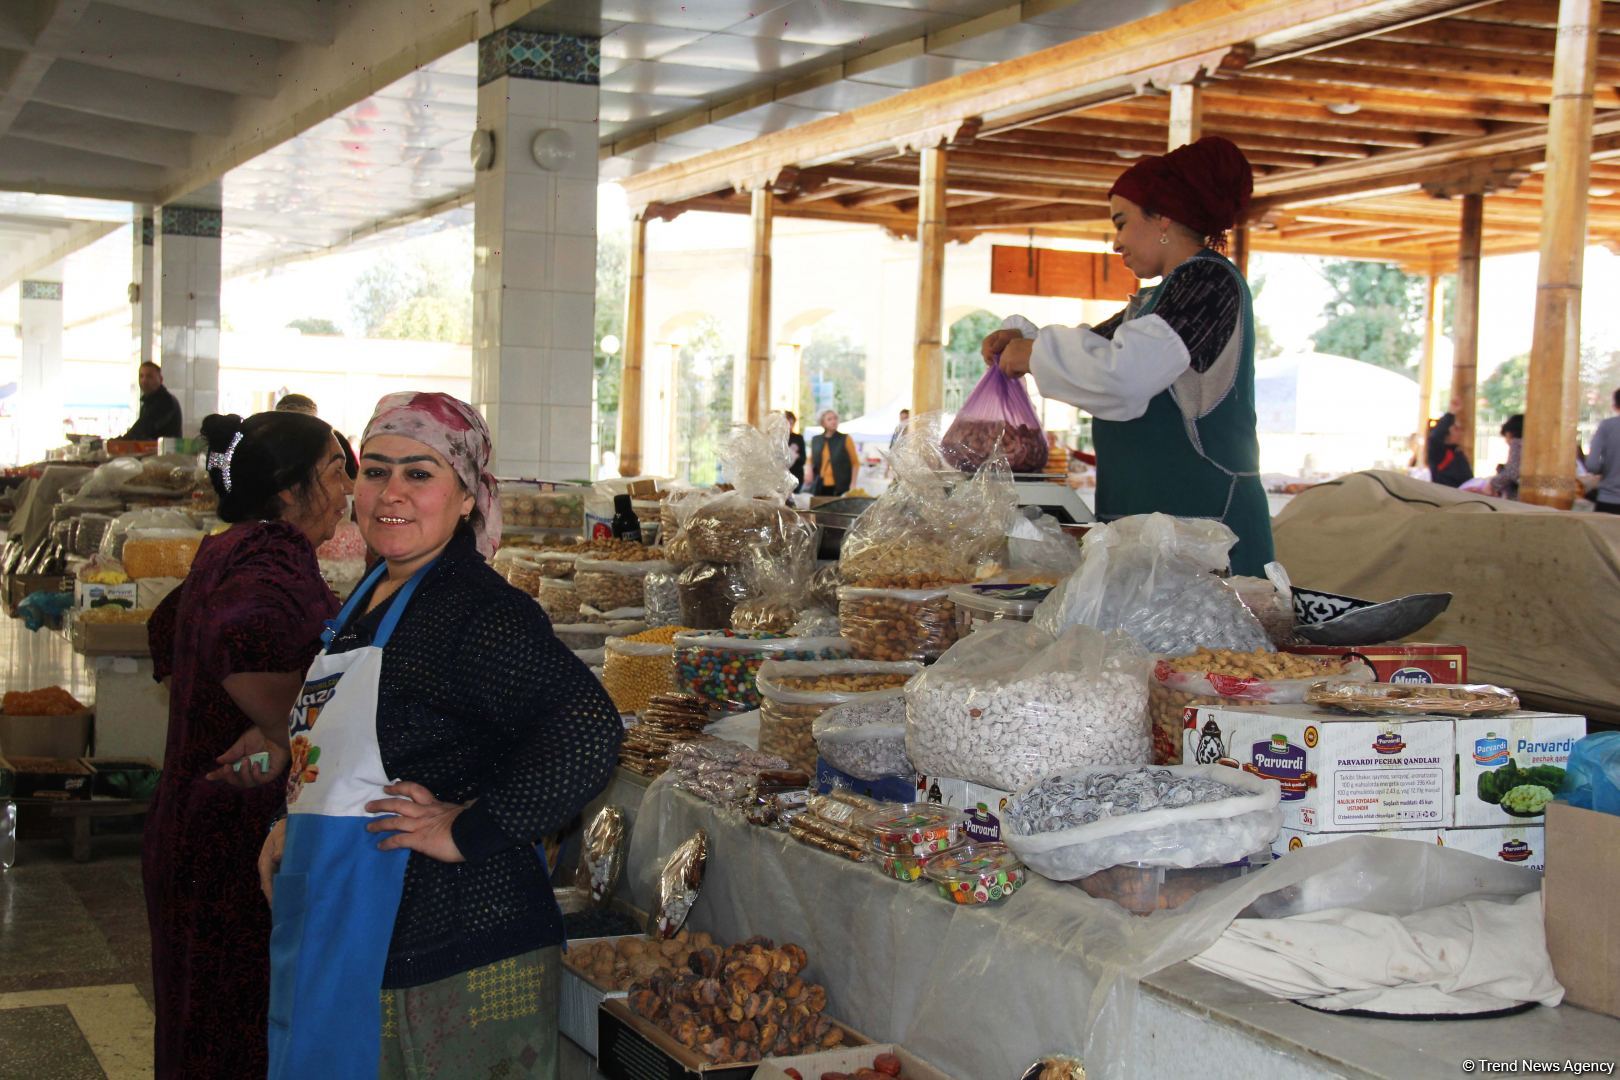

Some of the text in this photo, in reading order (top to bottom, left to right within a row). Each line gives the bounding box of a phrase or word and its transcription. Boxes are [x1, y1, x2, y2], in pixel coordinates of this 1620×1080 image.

[1477, 742, 1507, 753] Parvardi
[1517, 738, 1574, 754] Parvardi
[1255, 753, 1304, 770] Parvardi
[1403, 757, 1440, 765] QANDLARI
[965, 820, 999, 838] Parvardi
